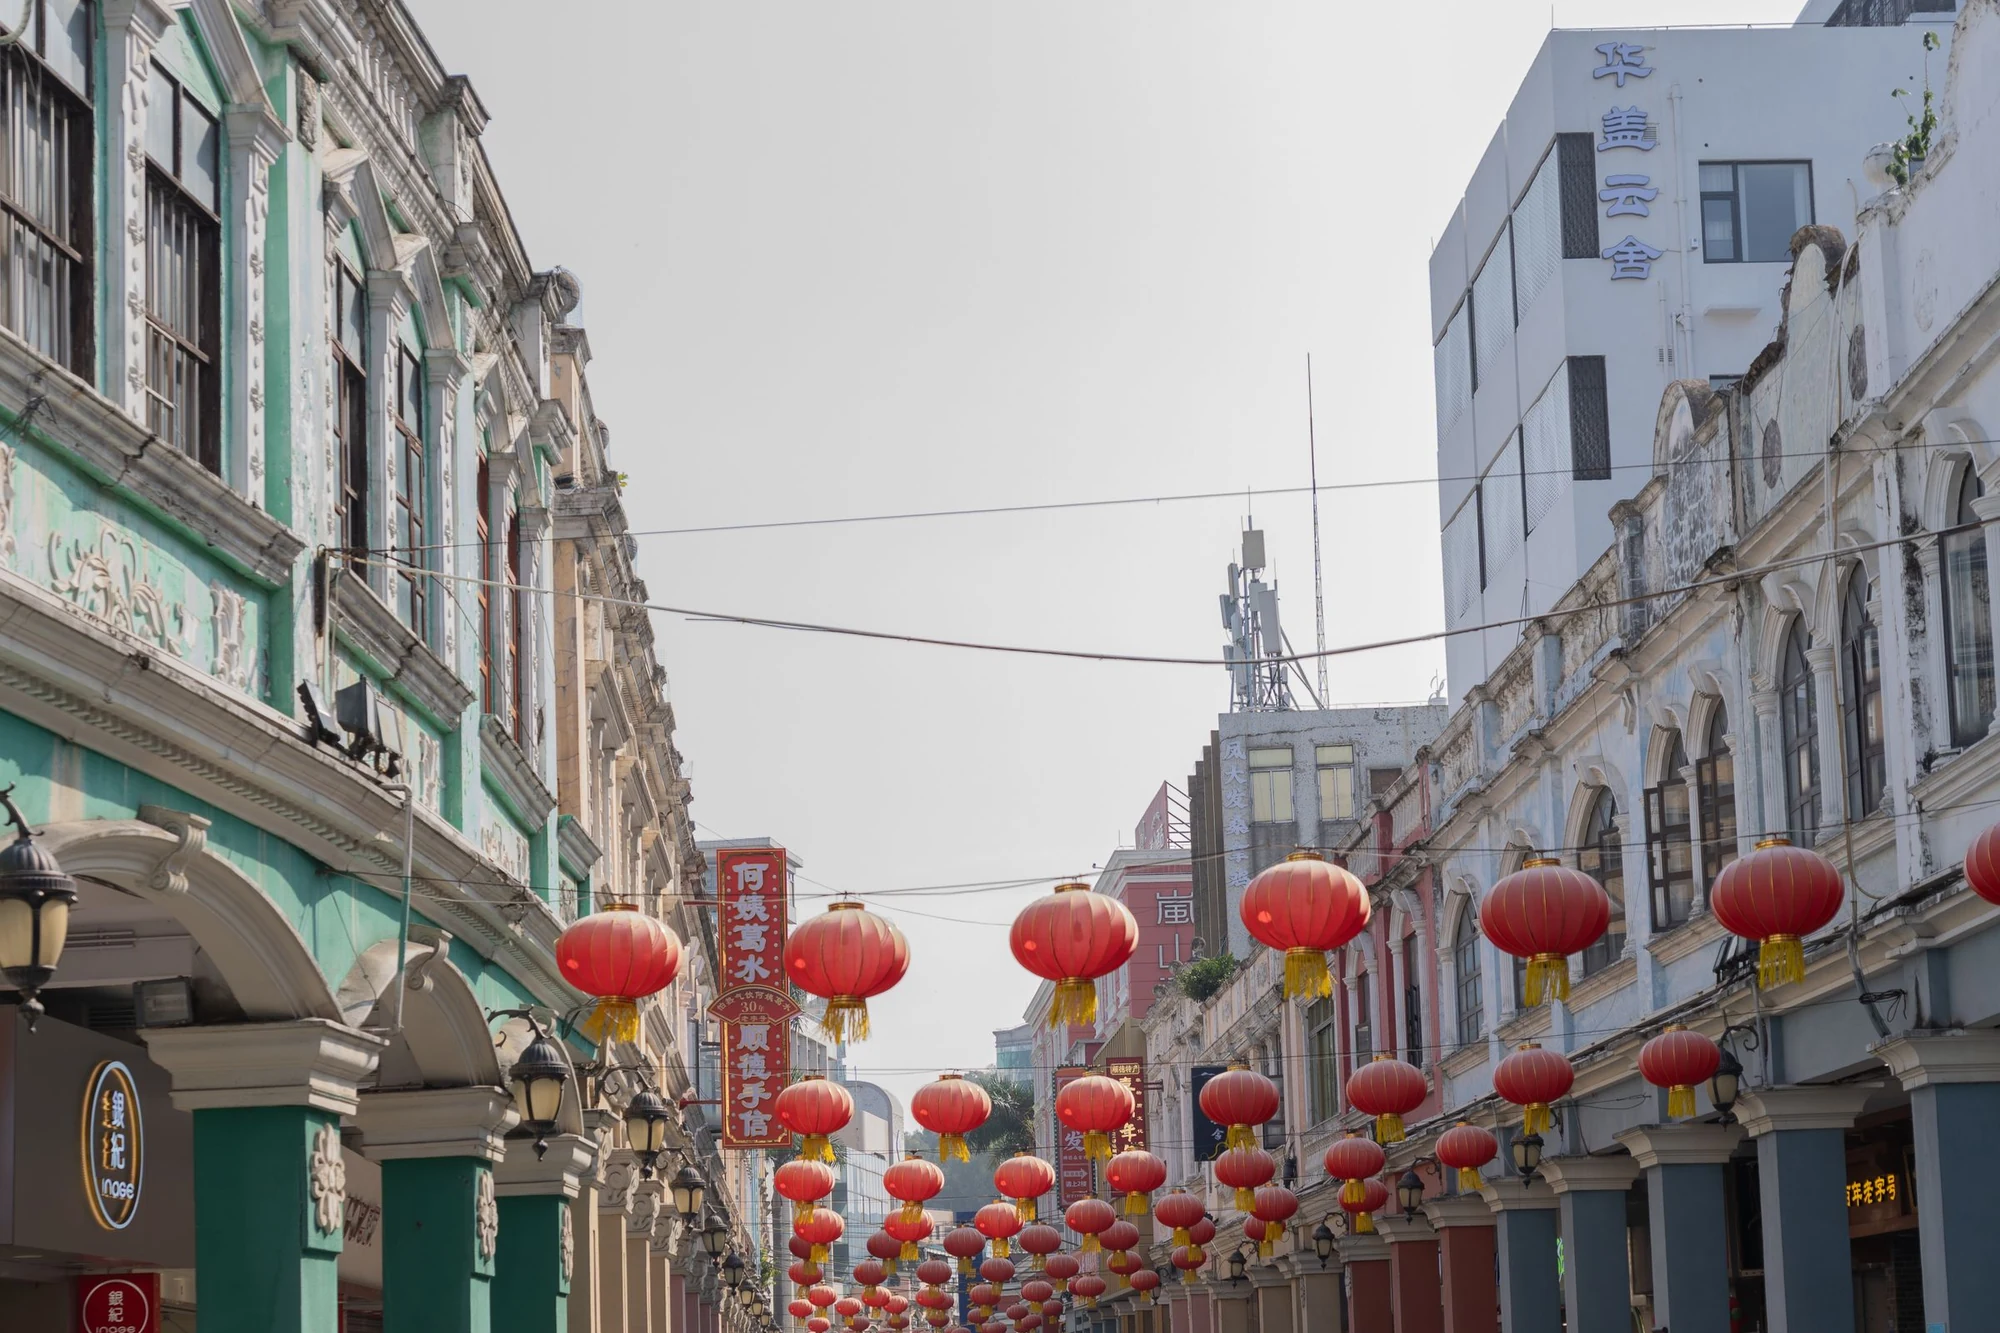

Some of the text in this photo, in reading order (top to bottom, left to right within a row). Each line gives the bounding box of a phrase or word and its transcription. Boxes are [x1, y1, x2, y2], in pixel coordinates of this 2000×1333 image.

[1593, 42, 1663, 280] 华盖云舍
[1156, 889, 1195, 980] 嵐山
[736, 1024, 772, 1138] 顺德手信
